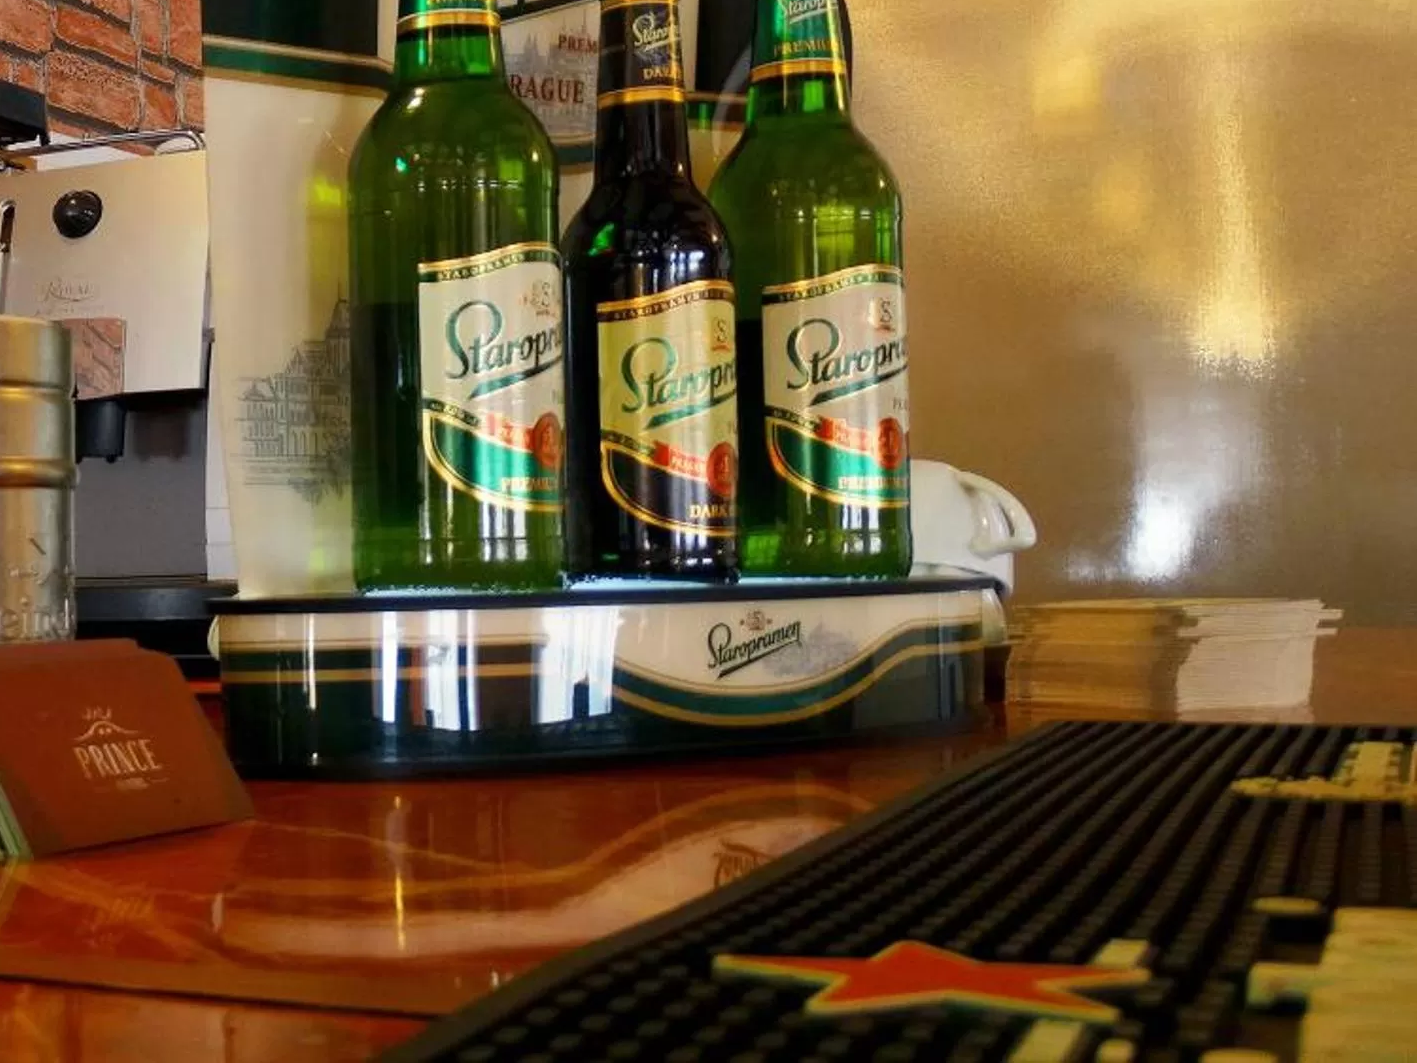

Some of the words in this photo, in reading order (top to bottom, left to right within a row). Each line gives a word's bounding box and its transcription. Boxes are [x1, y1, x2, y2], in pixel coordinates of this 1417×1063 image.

[558, 34, 598, 54] PREM
[510, 73, 585, 104] RAGUE
[708, 621, 801, 669] Staropramen
[73, 739, 163, 779] PRINCE
